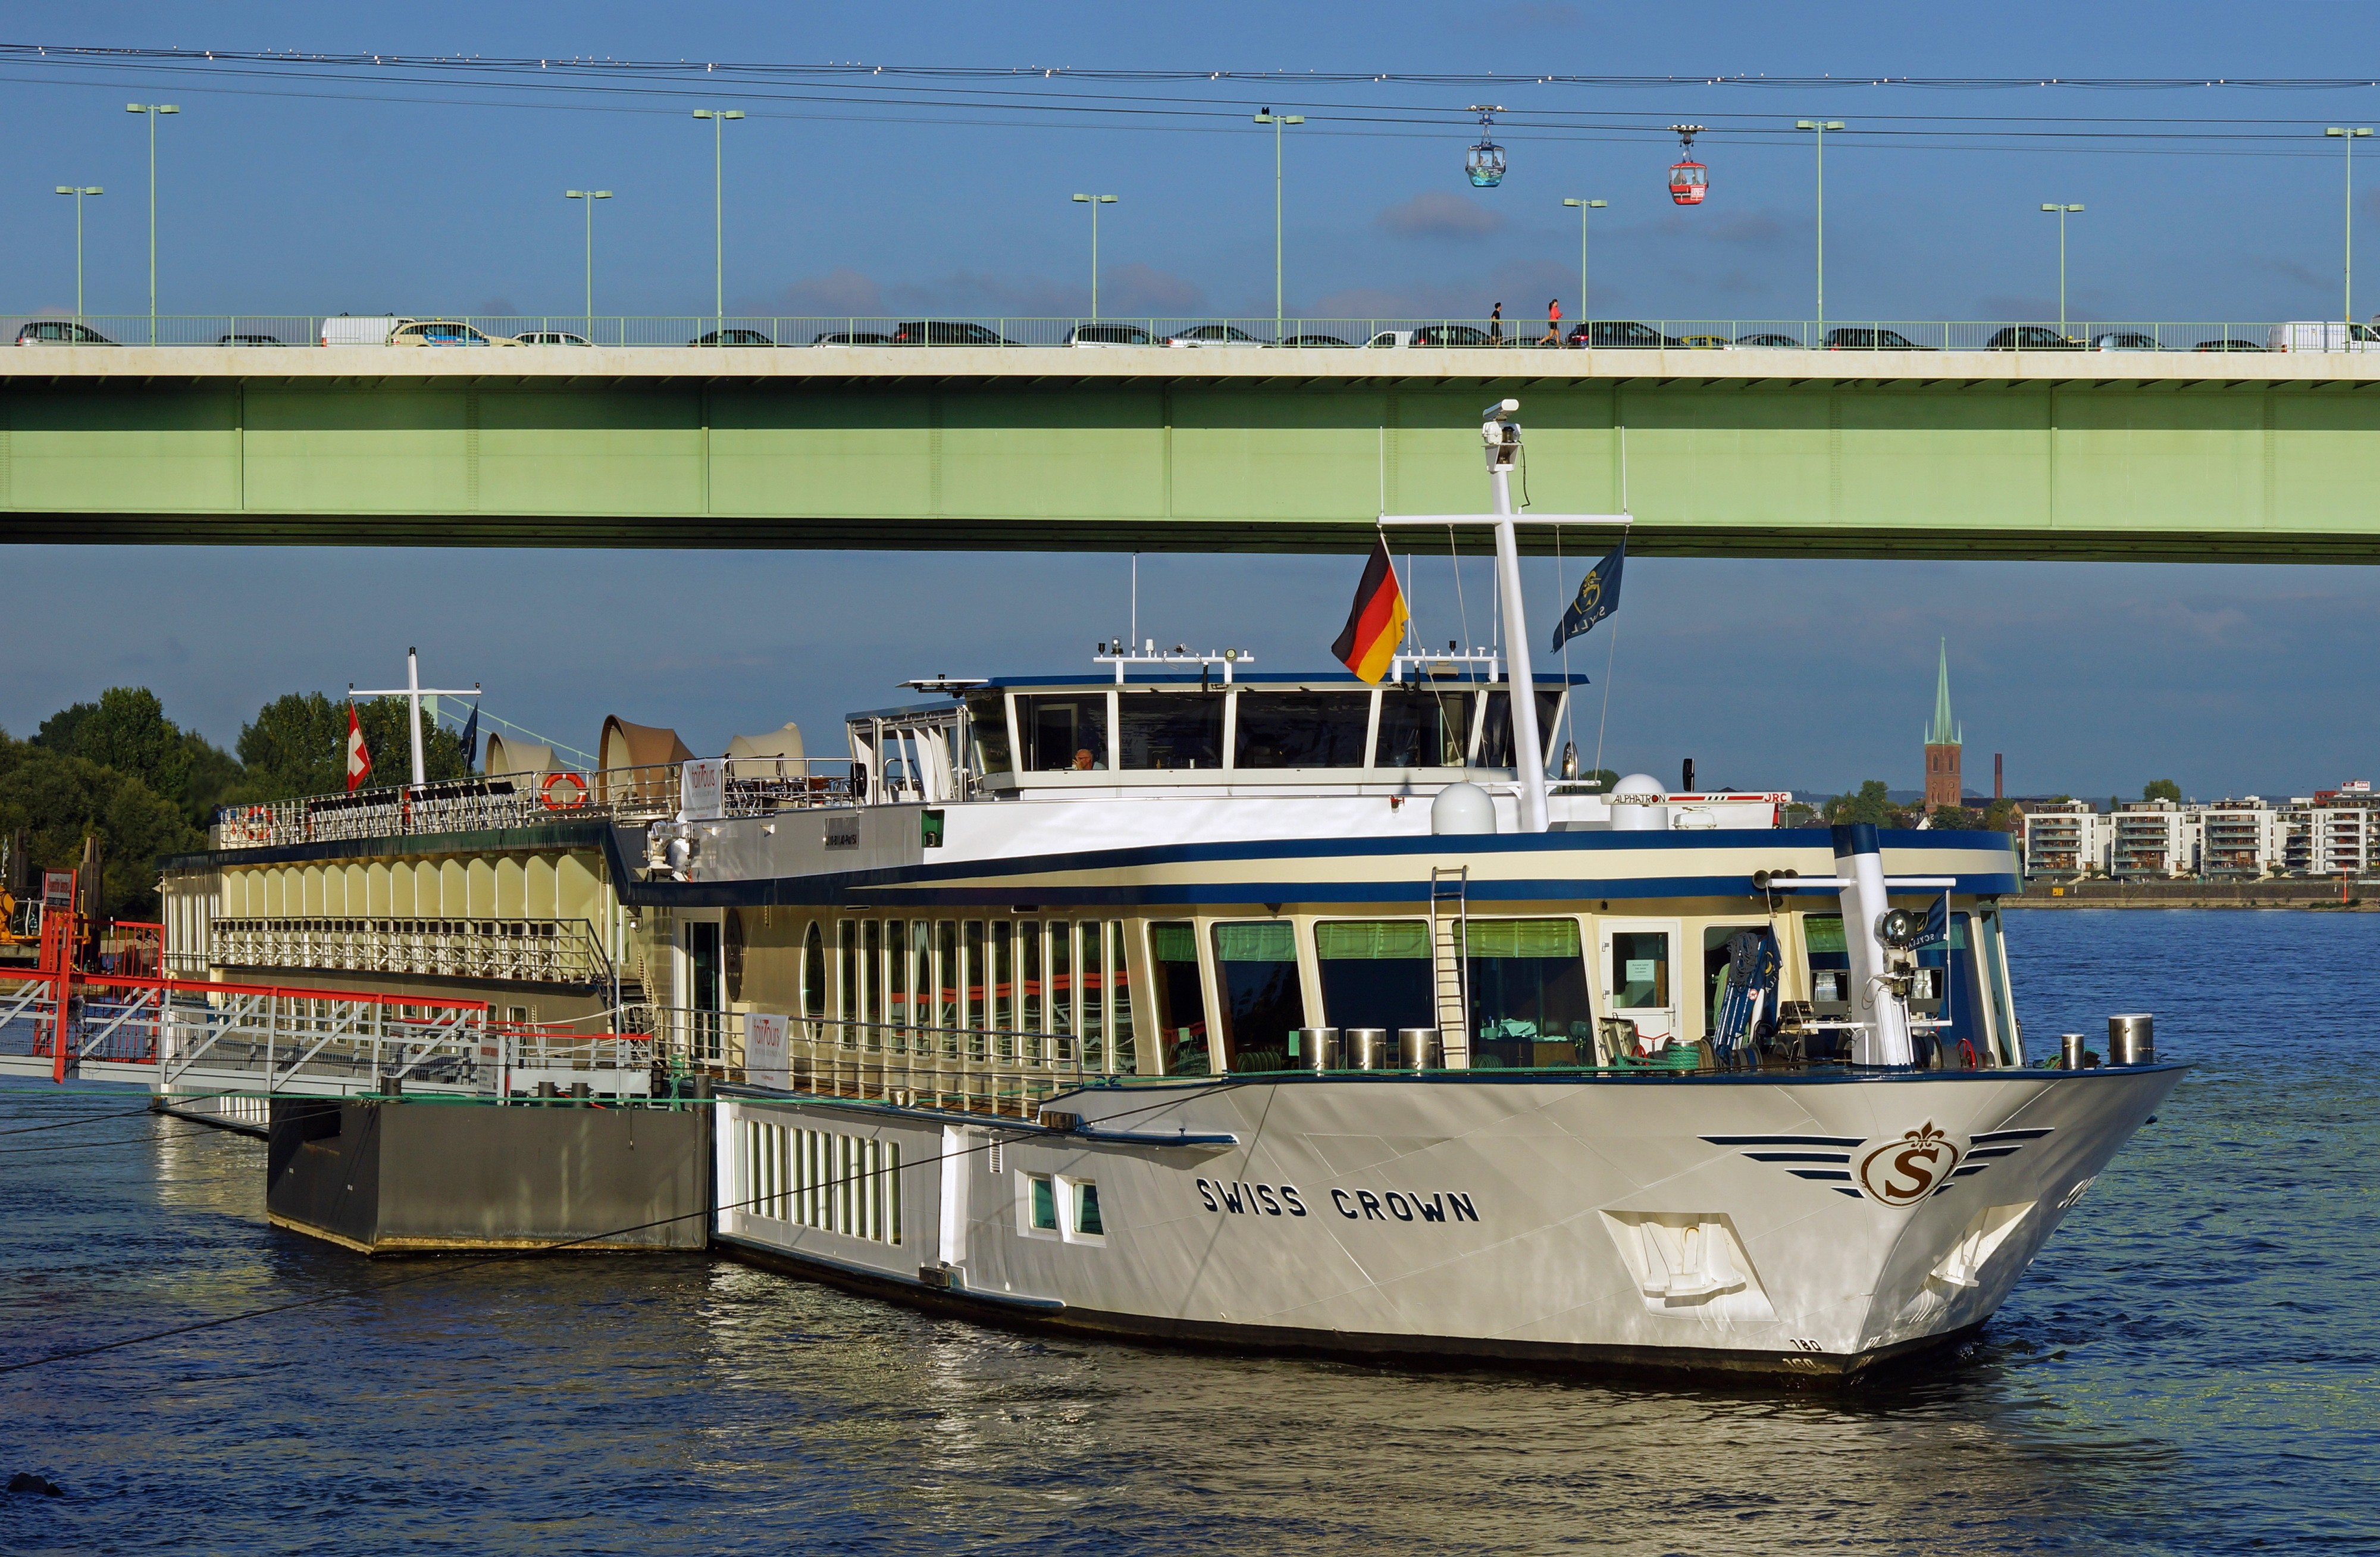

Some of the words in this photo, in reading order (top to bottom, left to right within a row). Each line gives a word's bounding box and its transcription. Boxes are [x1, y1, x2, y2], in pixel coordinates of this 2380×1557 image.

[1613, 794, 1666, 803] ALPHATRON
[1764, 793, 1787, 802] JRC
[753, 1019, 780, 1048] fairTours
[1196, 1177, 1307, 1217] SWISS
[1330, 1188, 1480, 1222] CROWN
[1790, 1338, 1822, 1351] 180
